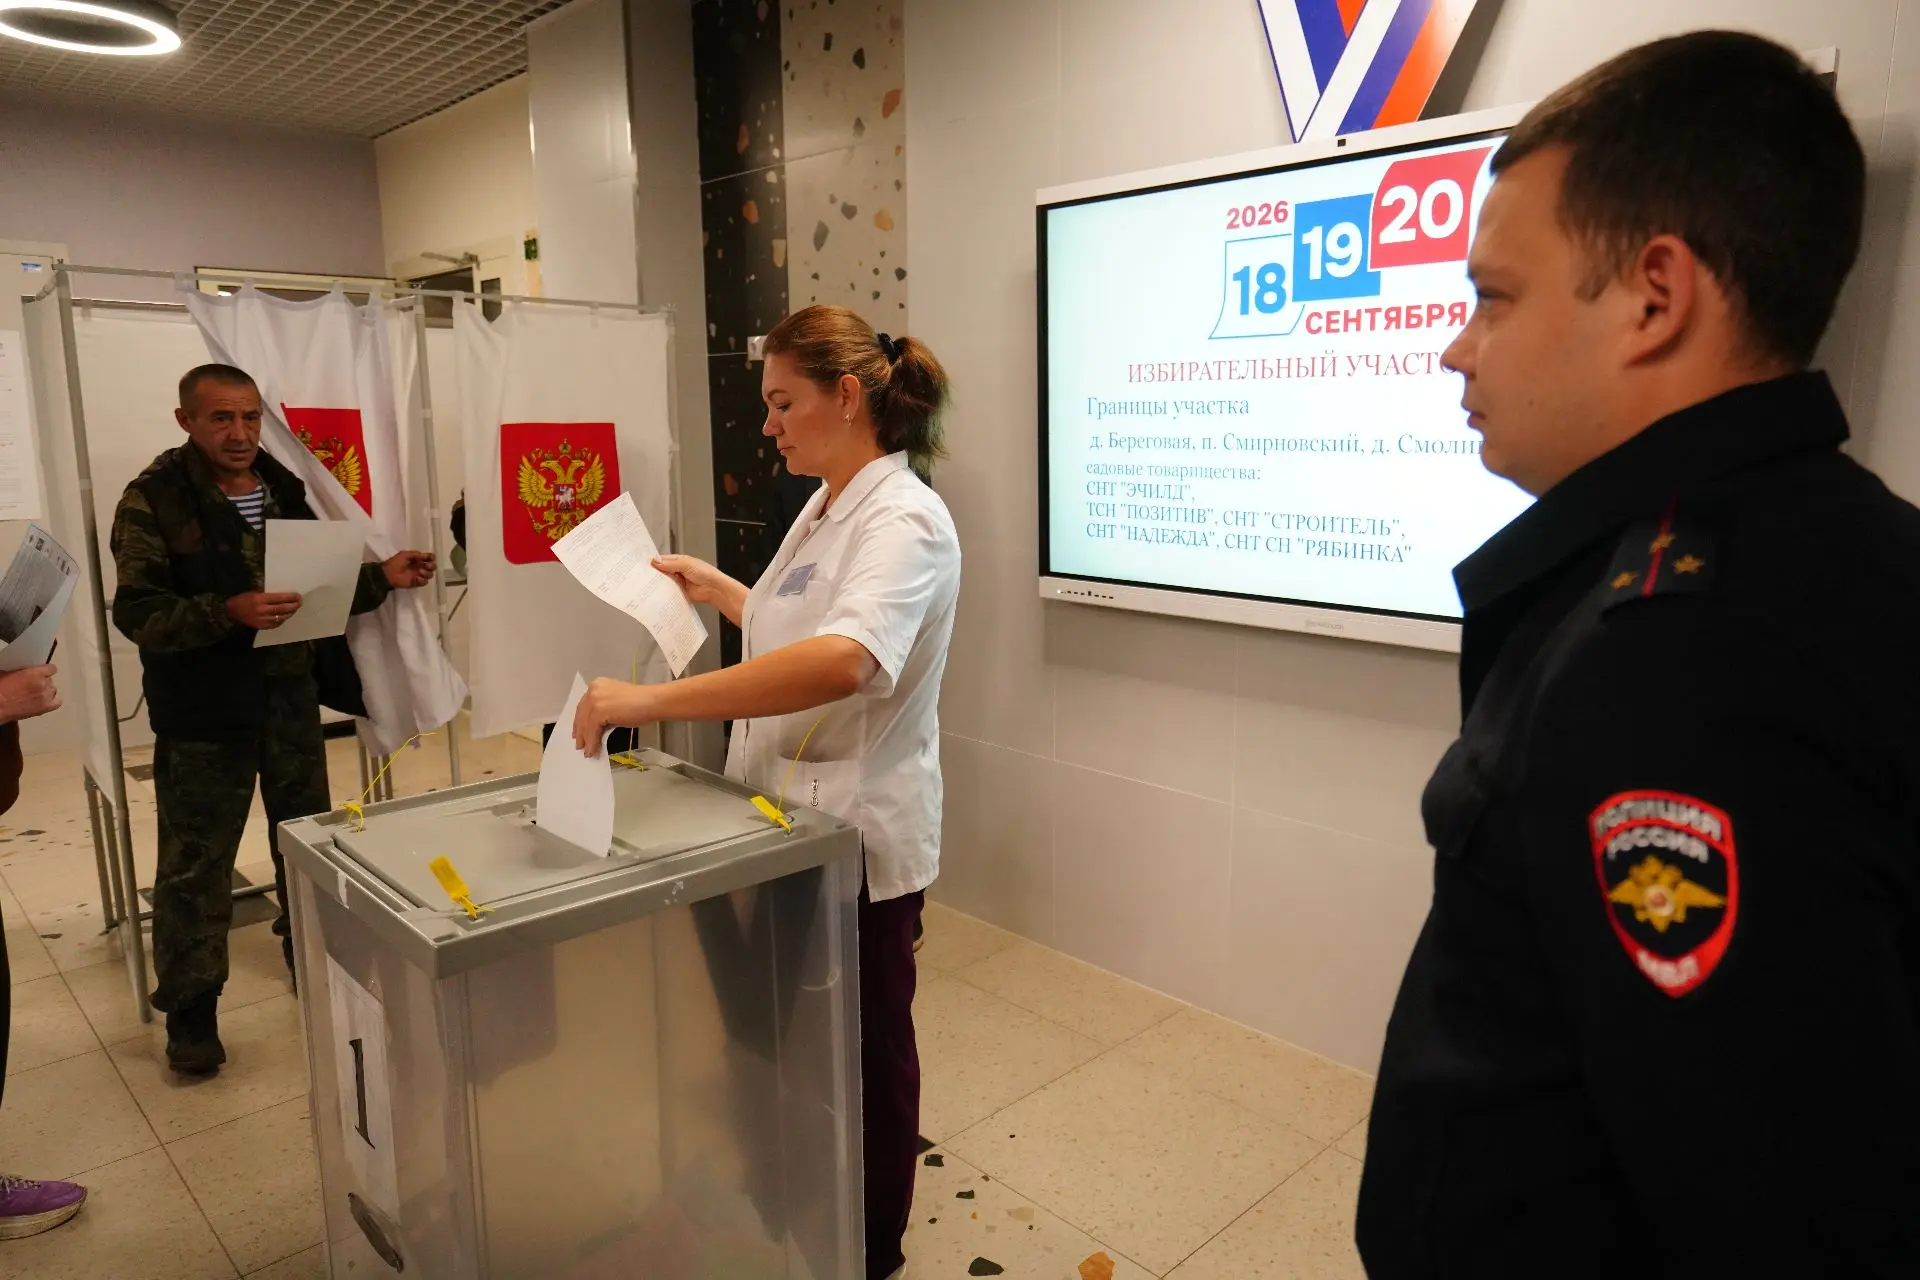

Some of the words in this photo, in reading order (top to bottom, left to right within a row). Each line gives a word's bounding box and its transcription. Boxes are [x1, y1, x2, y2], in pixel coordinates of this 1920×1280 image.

[1226, 200, 1289, 230] 2026
[1379, 178, 1464, 245] 20
[1301, 221, 1363, 280] 19
[1232, 262, 1287, 316] 18
[1305, 301, 1467, 335] СЕНТЯБРЯ
[1127, 349, 1338, 384] ИЗБИРАТЕЛЬНЫЙ
[1087, 397, 1168, 420] Границы
[1172, 399, 1250, 420] участка
[1089, 435, 1103, 449] д.
[1108, 431, 1196, 453] Береговая,
[1201, 436, 1217, 450] п.
[1223, 432, 1365, 456] Смирновский,
[1371, 439, 1390, 456] д.
[1086, 462, 1143, 477] садовые
[1146, 464, 1261, 481] товарищества:
[1086, 480, 1117, 497] СНТ
[1120, 481, 1196, 502] "ЭЧИЛД",
[1086, 502, 1116, 518] ТСН
[1120, 503, 1218, 526] "ПОЗИТИВ",
[1222, 509, 1260, 528] СНТ
[1264, 511, 1406, 540] "СТРОИТЕЛЬ",
[1086, 522, 1117, 539] СНТ
[1120, 524, 1220, 550] "НАДЕЖДА",
[1224, 533, 1261, 551] СНТ
[1265, 536, 1292, 554] СН
[1297, 537, 1412, 563] "РЯБИНКА"
